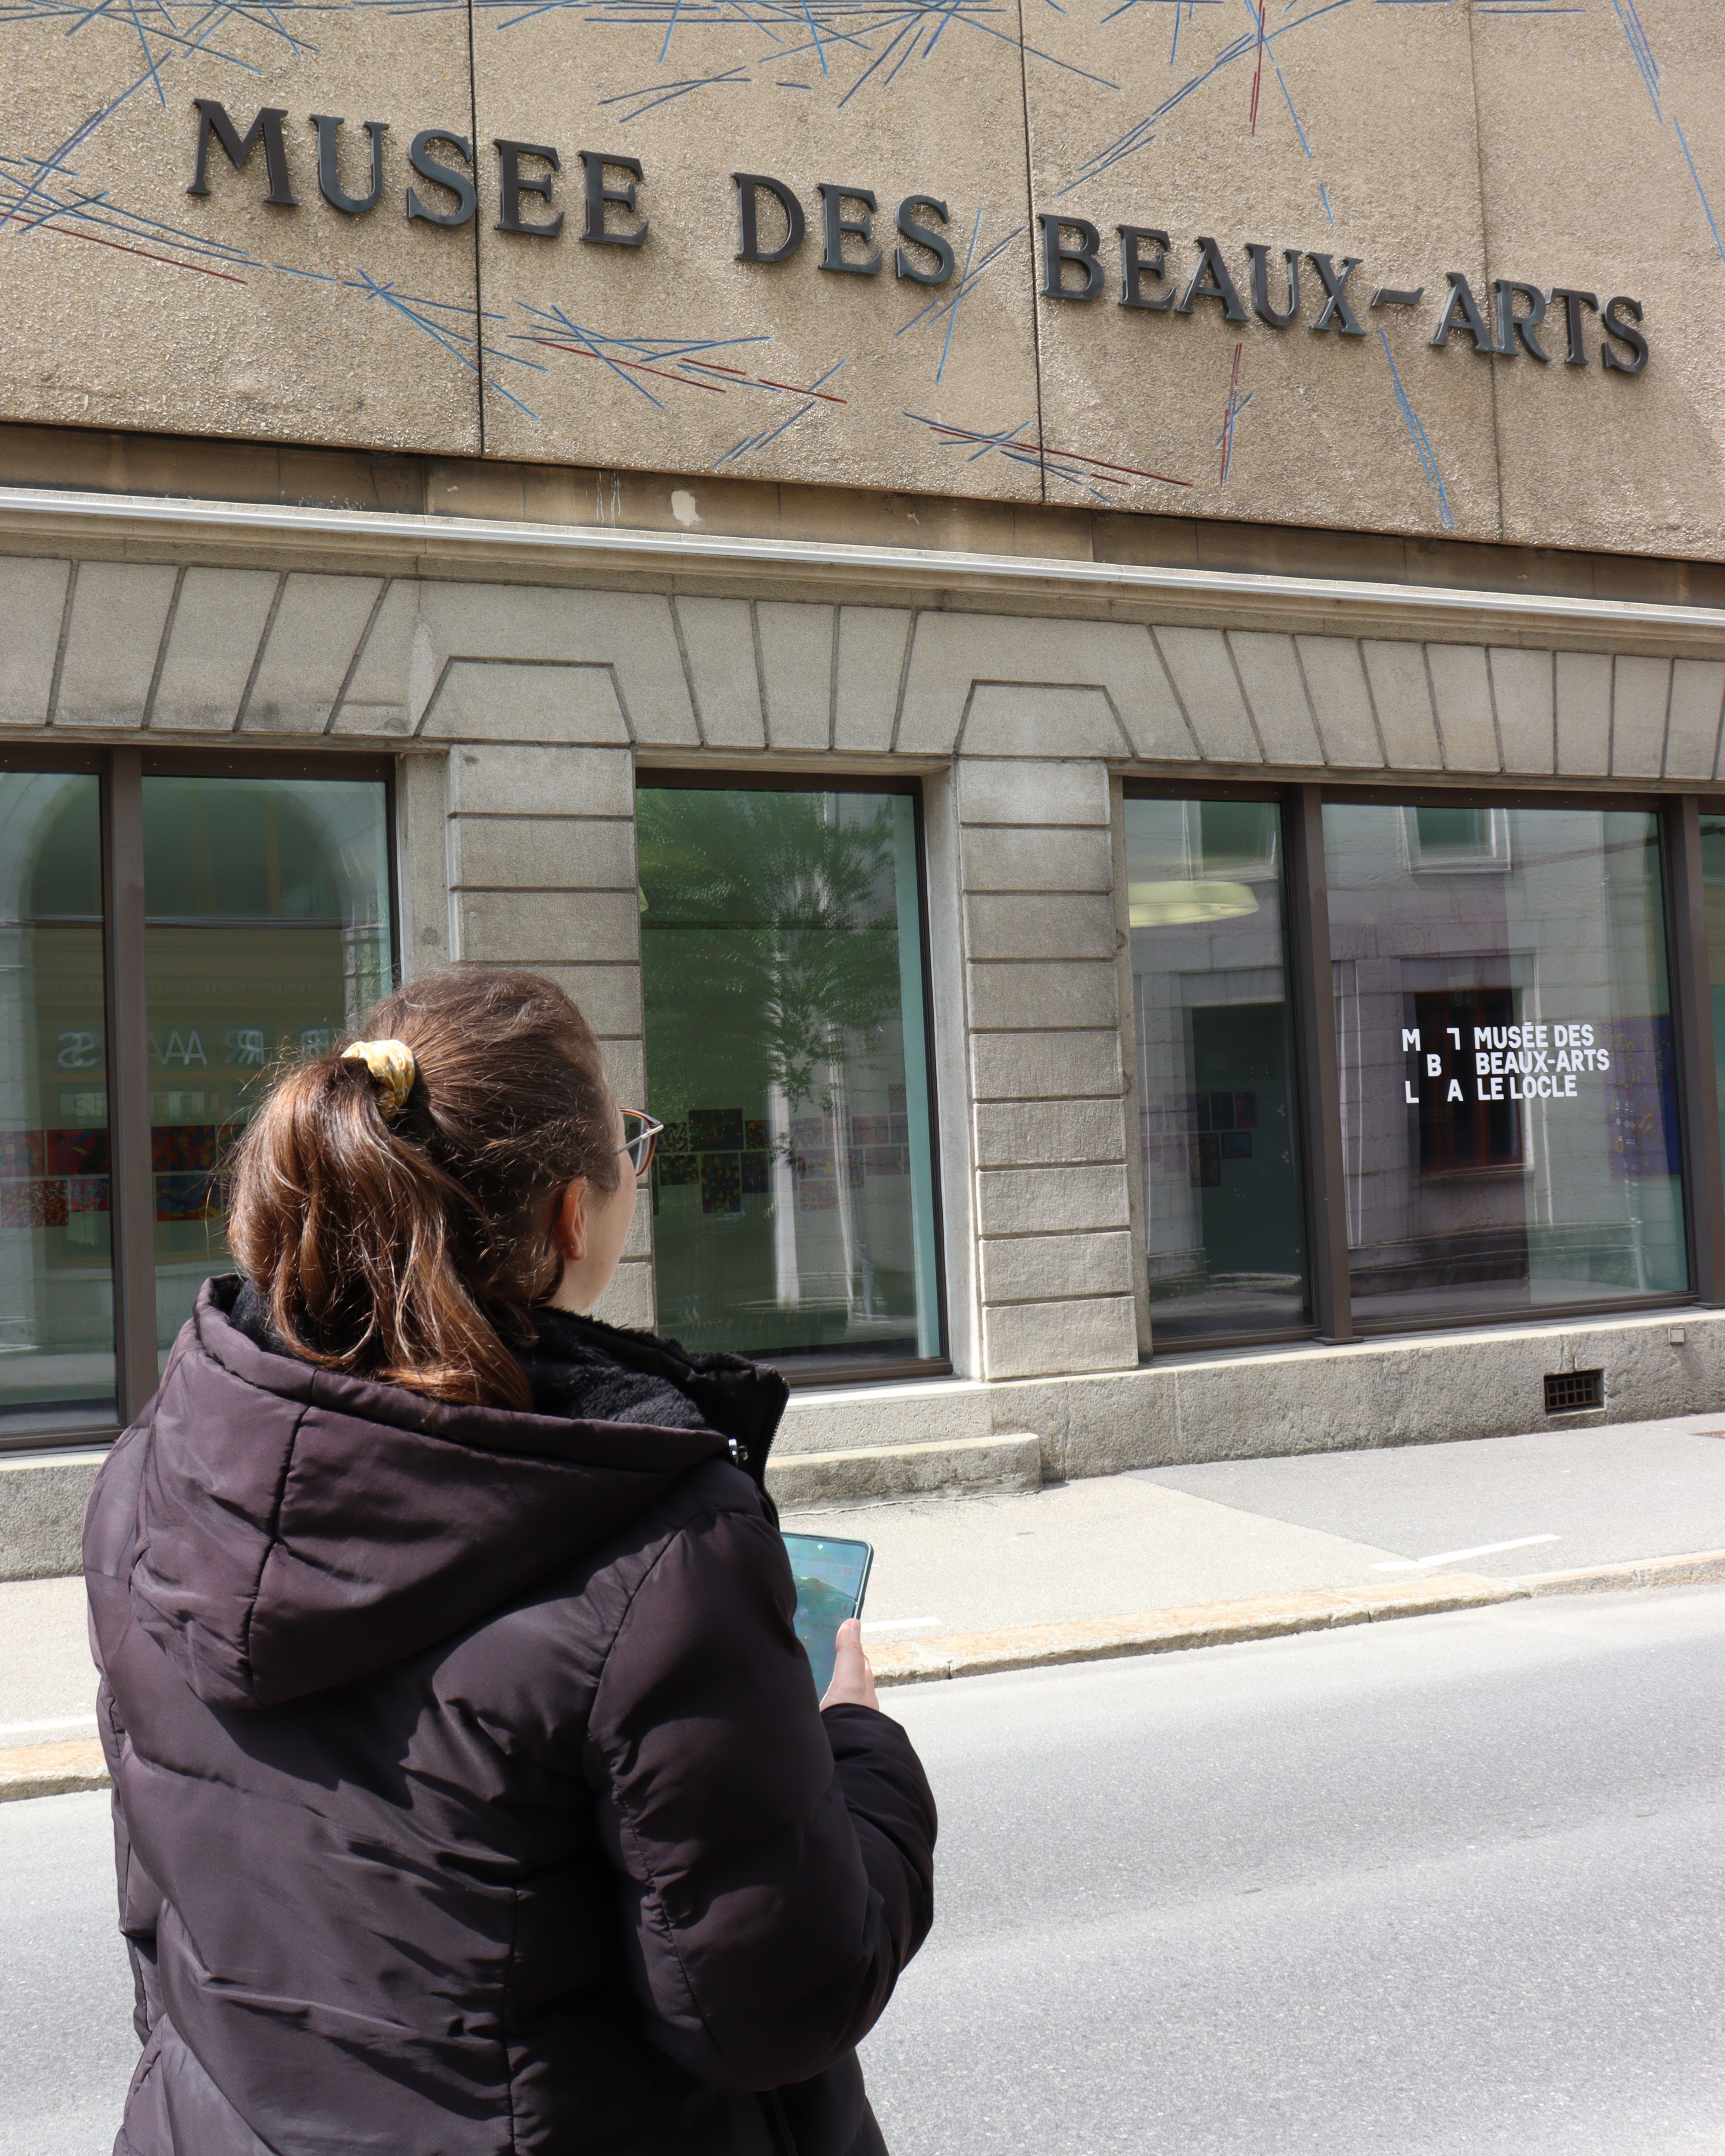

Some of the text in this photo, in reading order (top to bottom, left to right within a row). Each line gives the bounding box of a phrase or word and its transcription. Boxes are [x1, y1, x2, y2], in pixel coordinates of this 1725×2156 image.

[186, 98, 1649, 373] MUSEE DES BEAUX-ARTS
[1474, 1022, 1594, 1050] MUSÉE DES
[1427, 1054, 1442, 1077] B
[1475, 1049, 1610, 1075] BEAUX-ARTS
[1447, 1079, 1464, 1102] A
[1477, 1075, 1578, 1100] LE LOCLE
